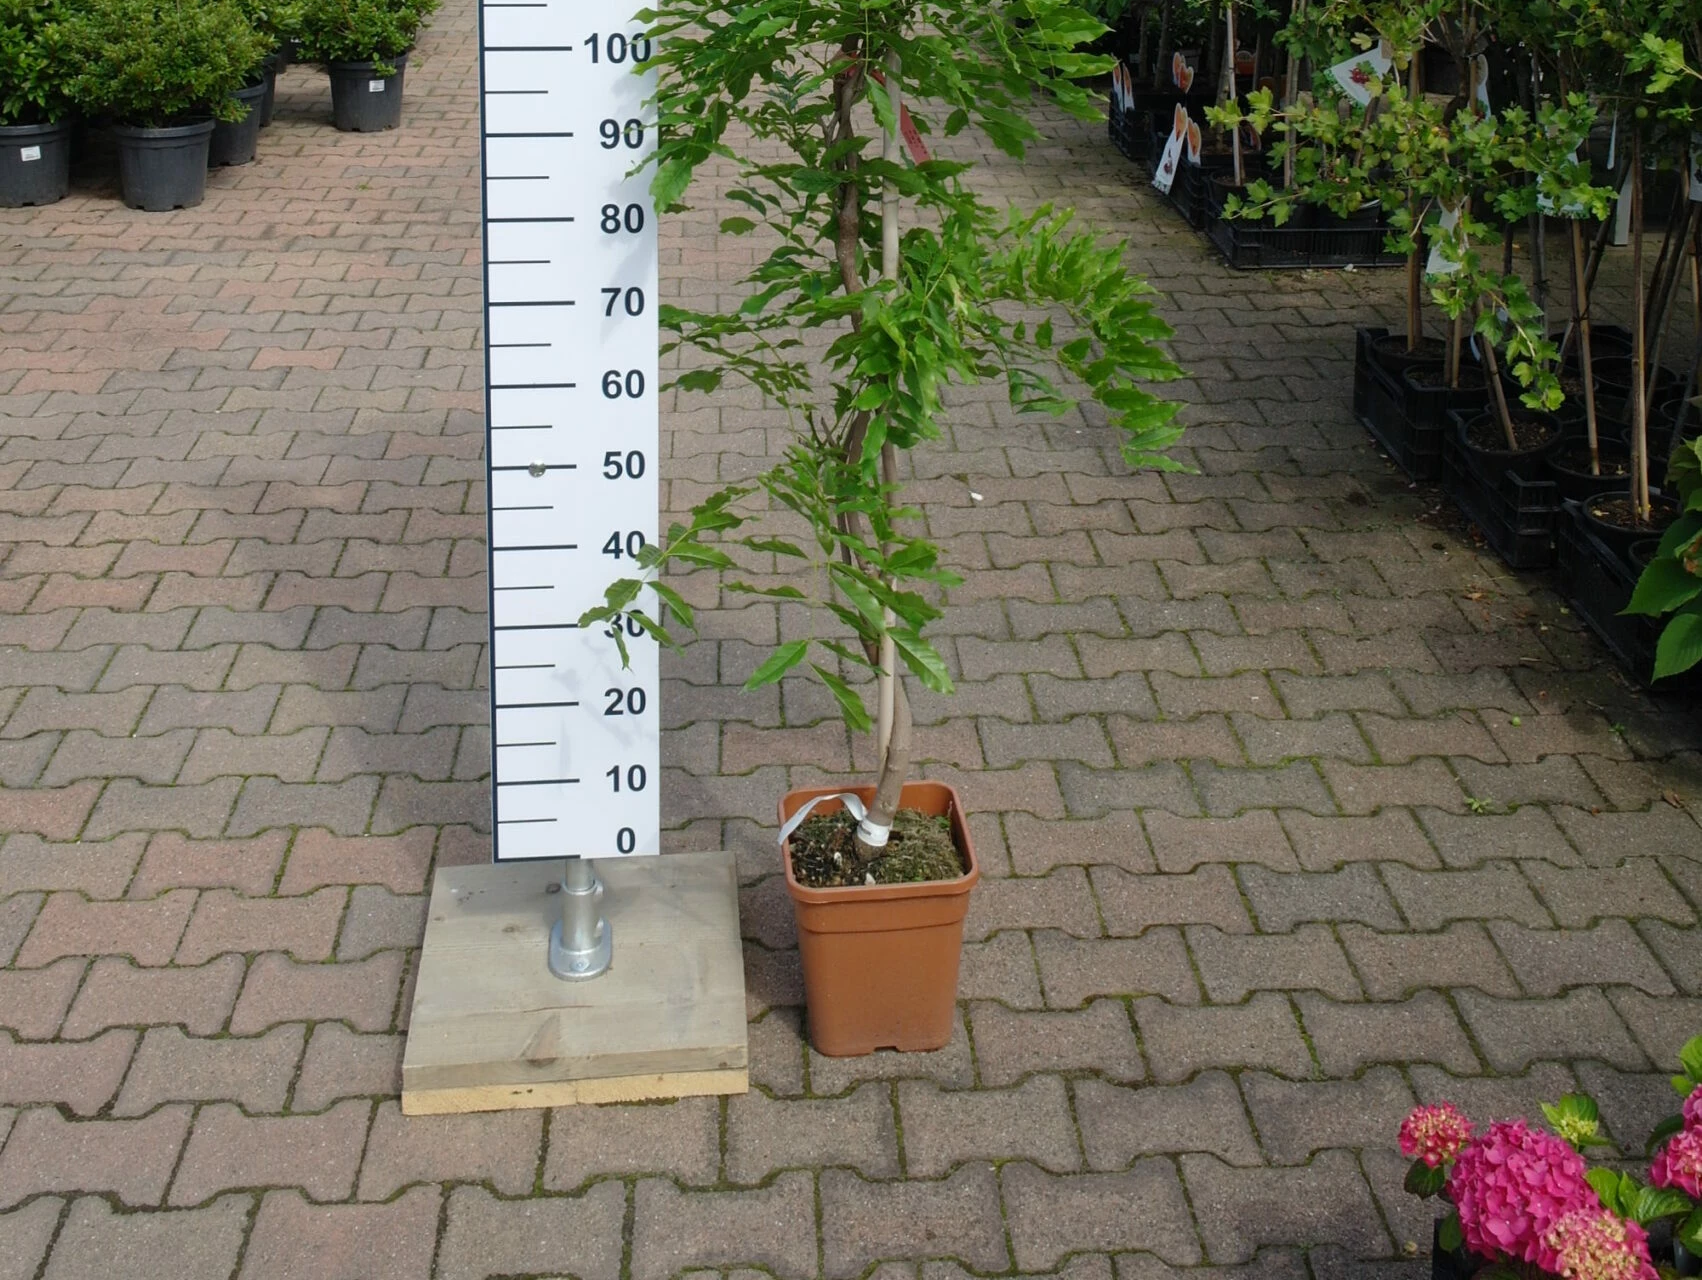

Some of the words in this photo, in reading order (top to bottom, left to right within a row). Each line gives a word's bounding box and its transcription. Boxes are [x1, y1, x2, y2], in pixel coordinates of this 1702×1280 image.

[584, 33, 651, 64] 100
[599, 119, 644, 149] 90
[600, 203, 645, 234] 80
[601, 286, 645, 317] 70
[602, 369, 646, 399] 60
[603, 450, 646, 480] 50
[602, 530, 646, 559] 40
[604, 687, 647, 716] 20
[605, 764, 647, 792] 10
[617, 827, 636, 854] 0
